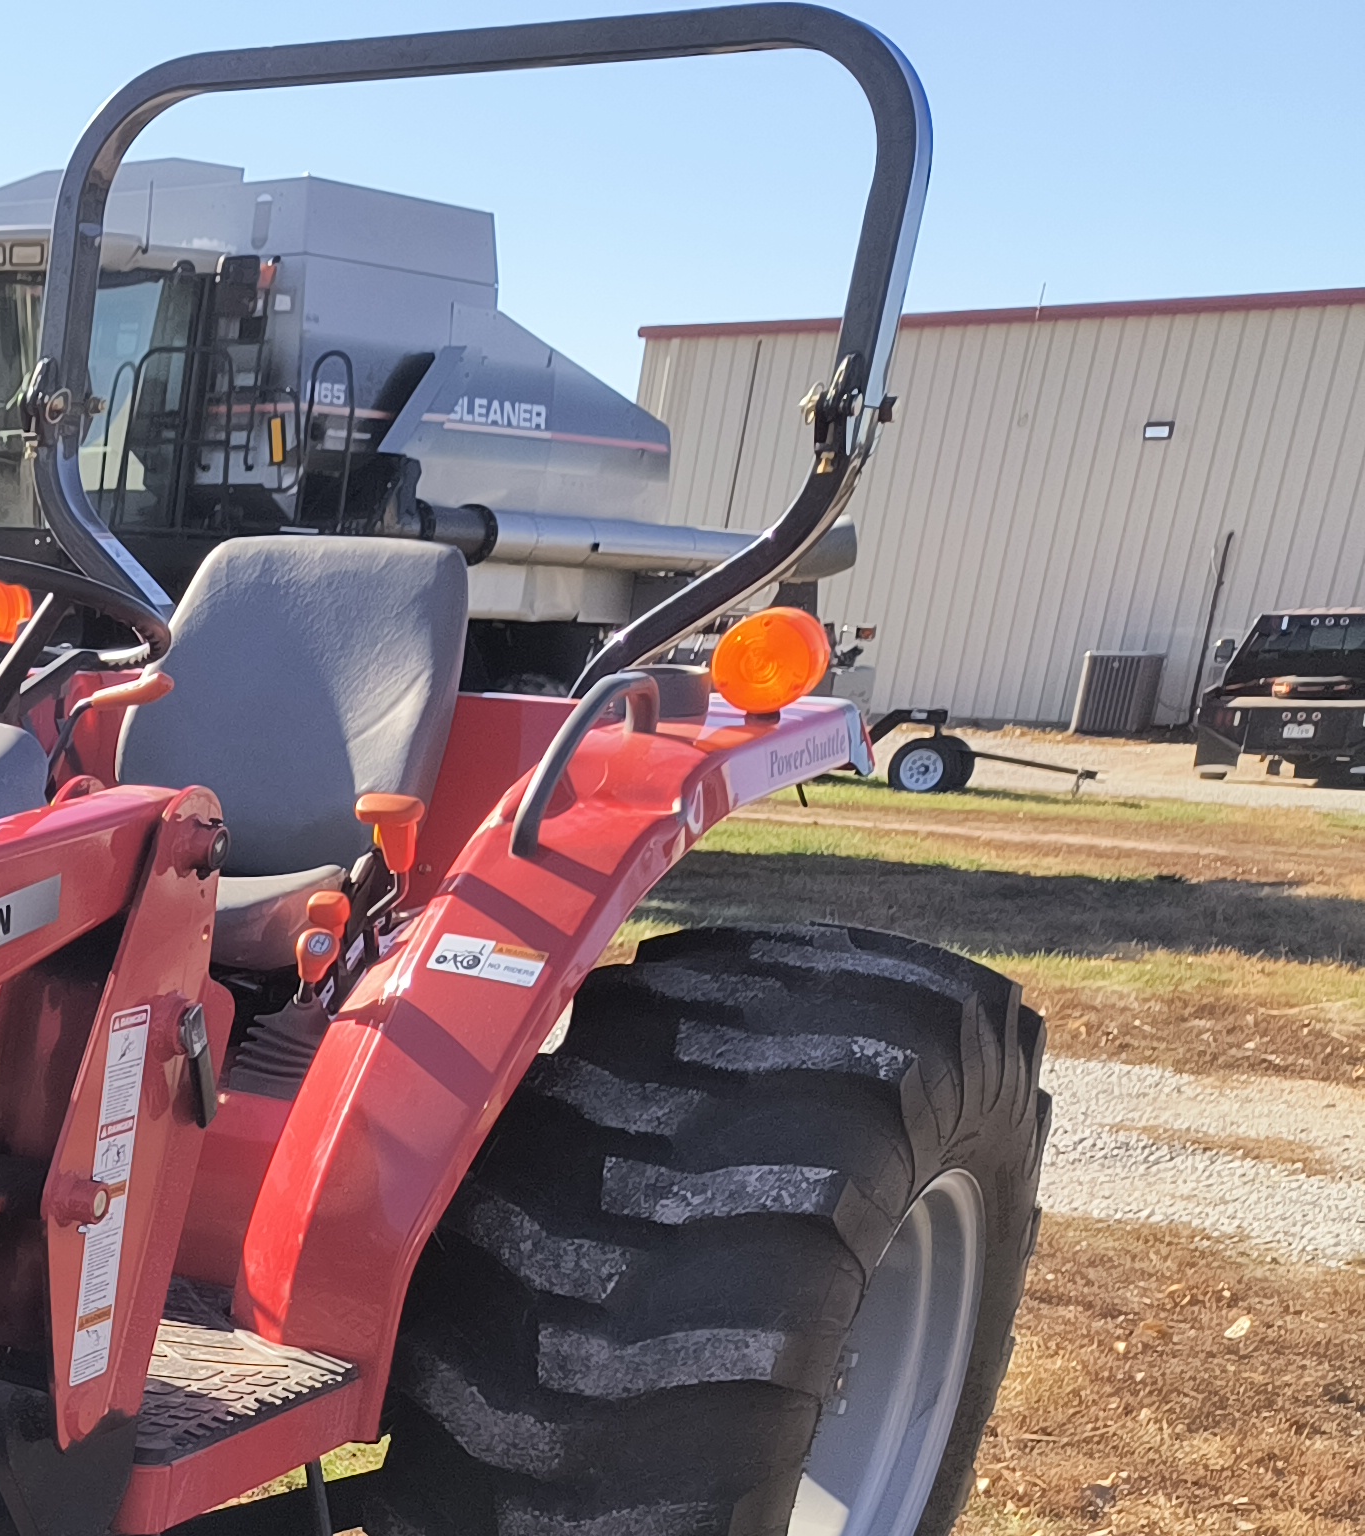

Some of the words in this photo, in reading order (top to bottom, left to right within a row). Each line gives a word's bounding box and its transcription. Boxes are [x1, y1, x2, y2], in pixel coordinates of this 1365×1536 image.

[769, 728, 847, 778] PowerShuttle
[487, 962, 501, 970] NO
[503, 966, 535, 977] RIDERS
